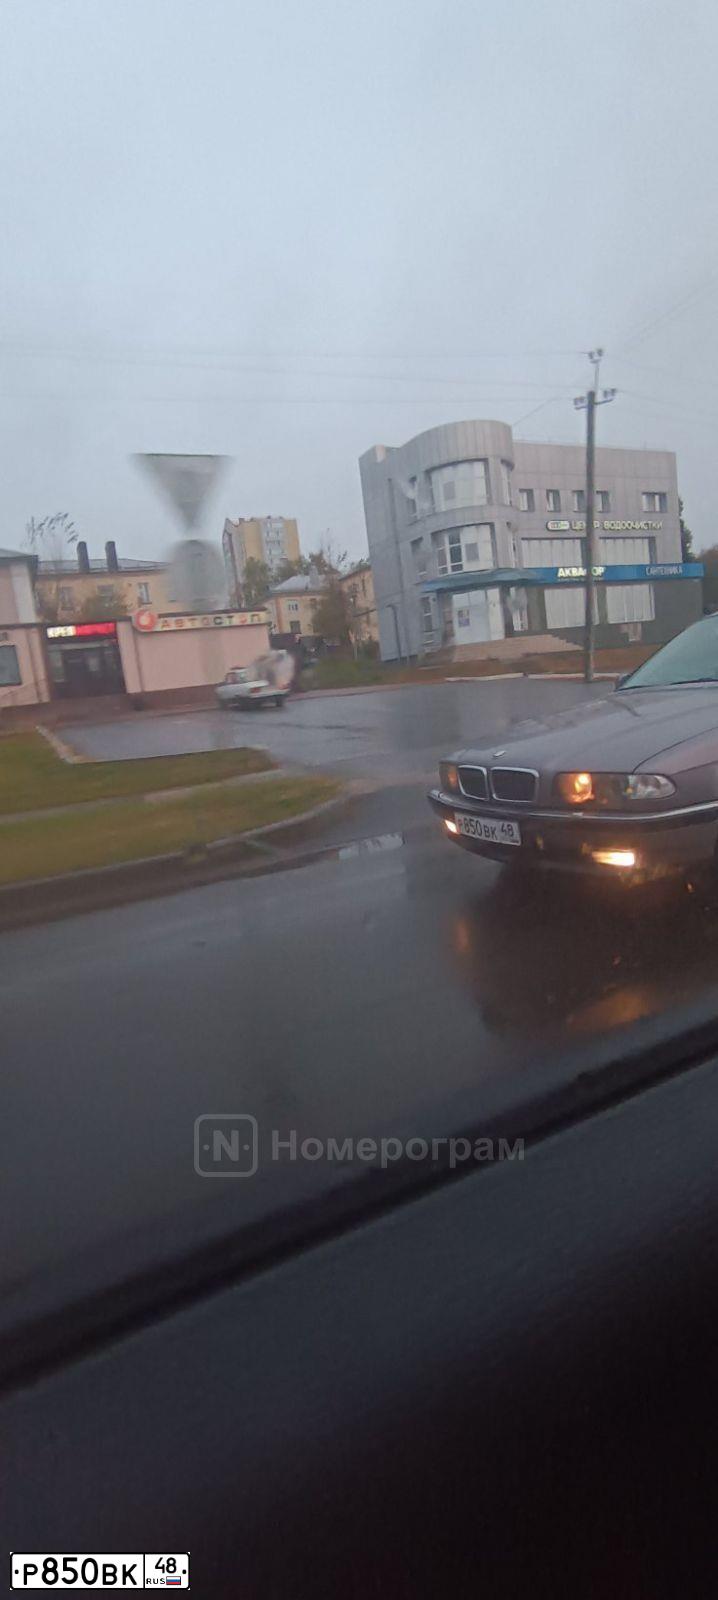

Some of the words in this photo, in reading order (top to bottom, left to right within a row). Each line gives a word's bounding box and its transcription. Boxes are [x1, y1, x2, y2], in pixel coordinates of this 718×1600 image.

[603, 519, 663, 531] ВОДООЧИСТКИ
[557, 566, 606, 578] АКВАОР
[160, 613, 263, 630] АВТОСТОП
[501, 822, 515, 838] 48
